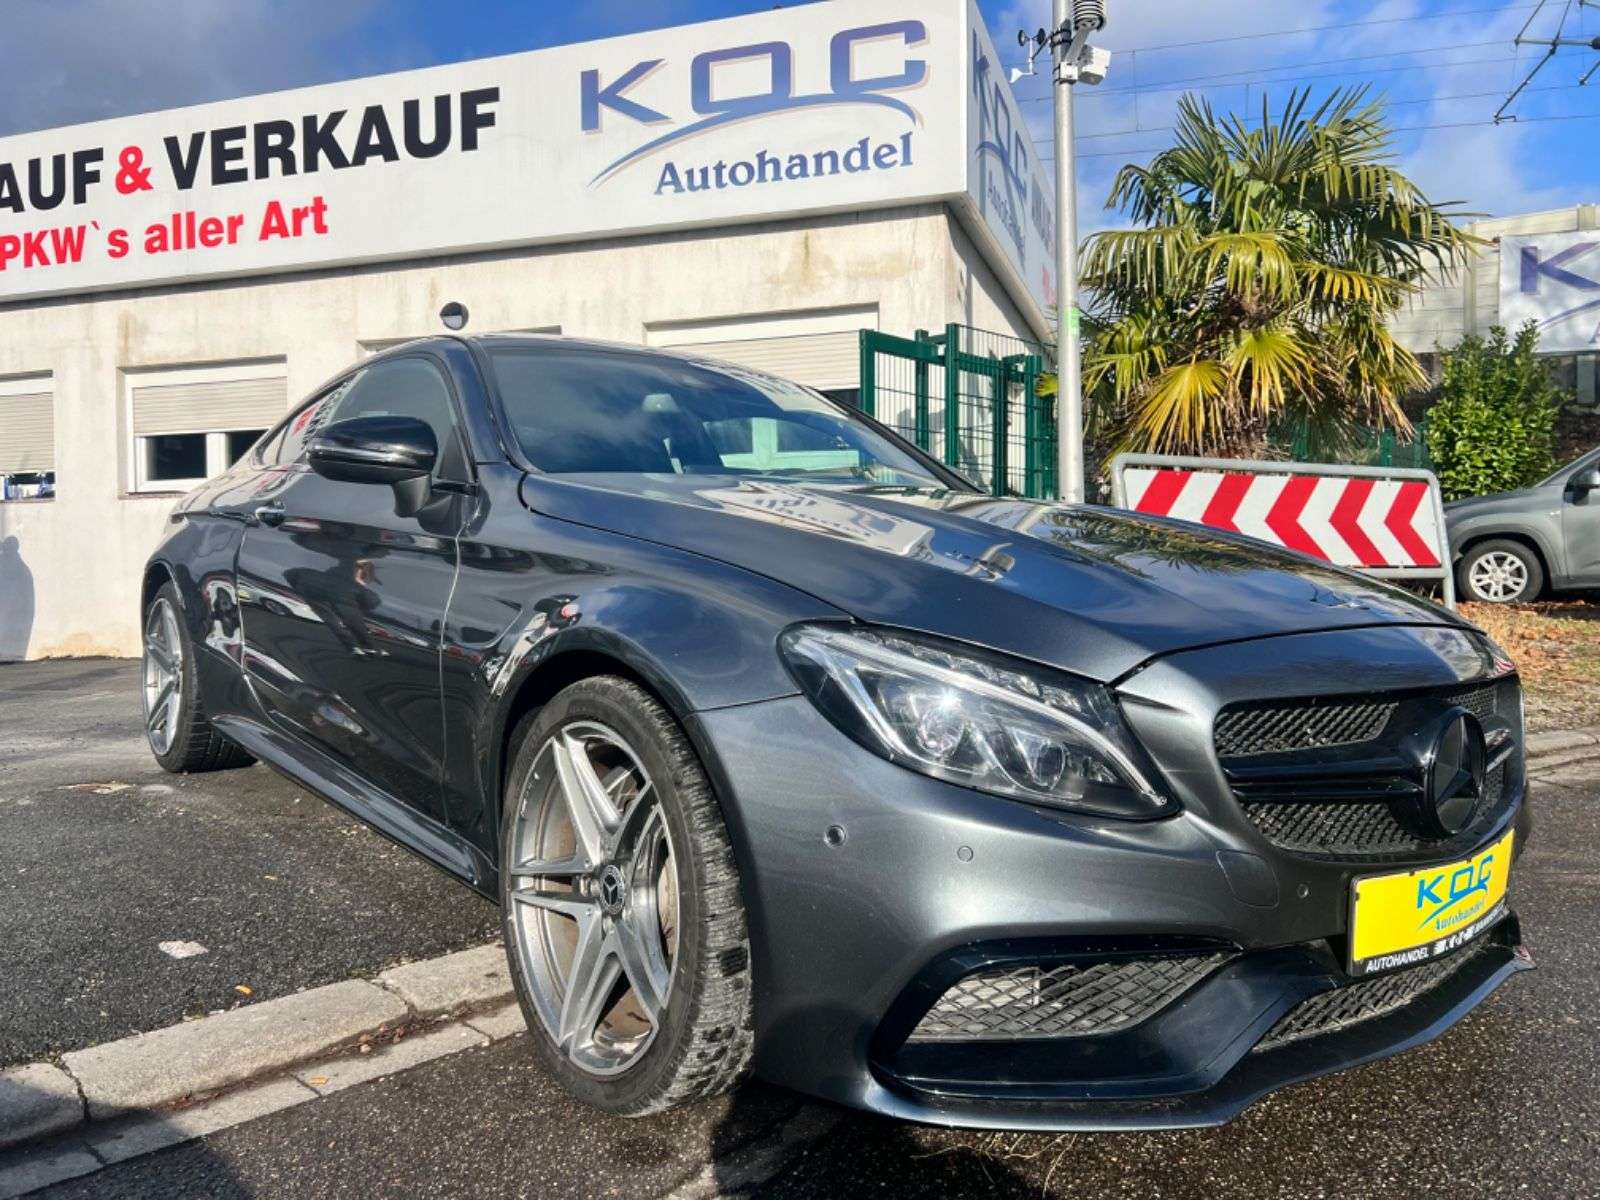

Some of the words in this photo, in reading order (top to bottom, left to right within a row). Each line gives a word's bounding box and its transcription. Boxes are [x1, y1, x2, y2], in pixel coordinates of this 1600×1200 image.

[581, 20, 928, 133] KOC
[115, 146, 154, 195] &
[163, 87, 500, 190] VERKAUF
[654, 131, 914, 195] Autohandel
[144, 211, 244, 256] aller
[259, 196, 328, 241] Art
[1416, 855, 1494, 909] KOC
[1366, 947, 1430, 973] AUTOHANDEL
